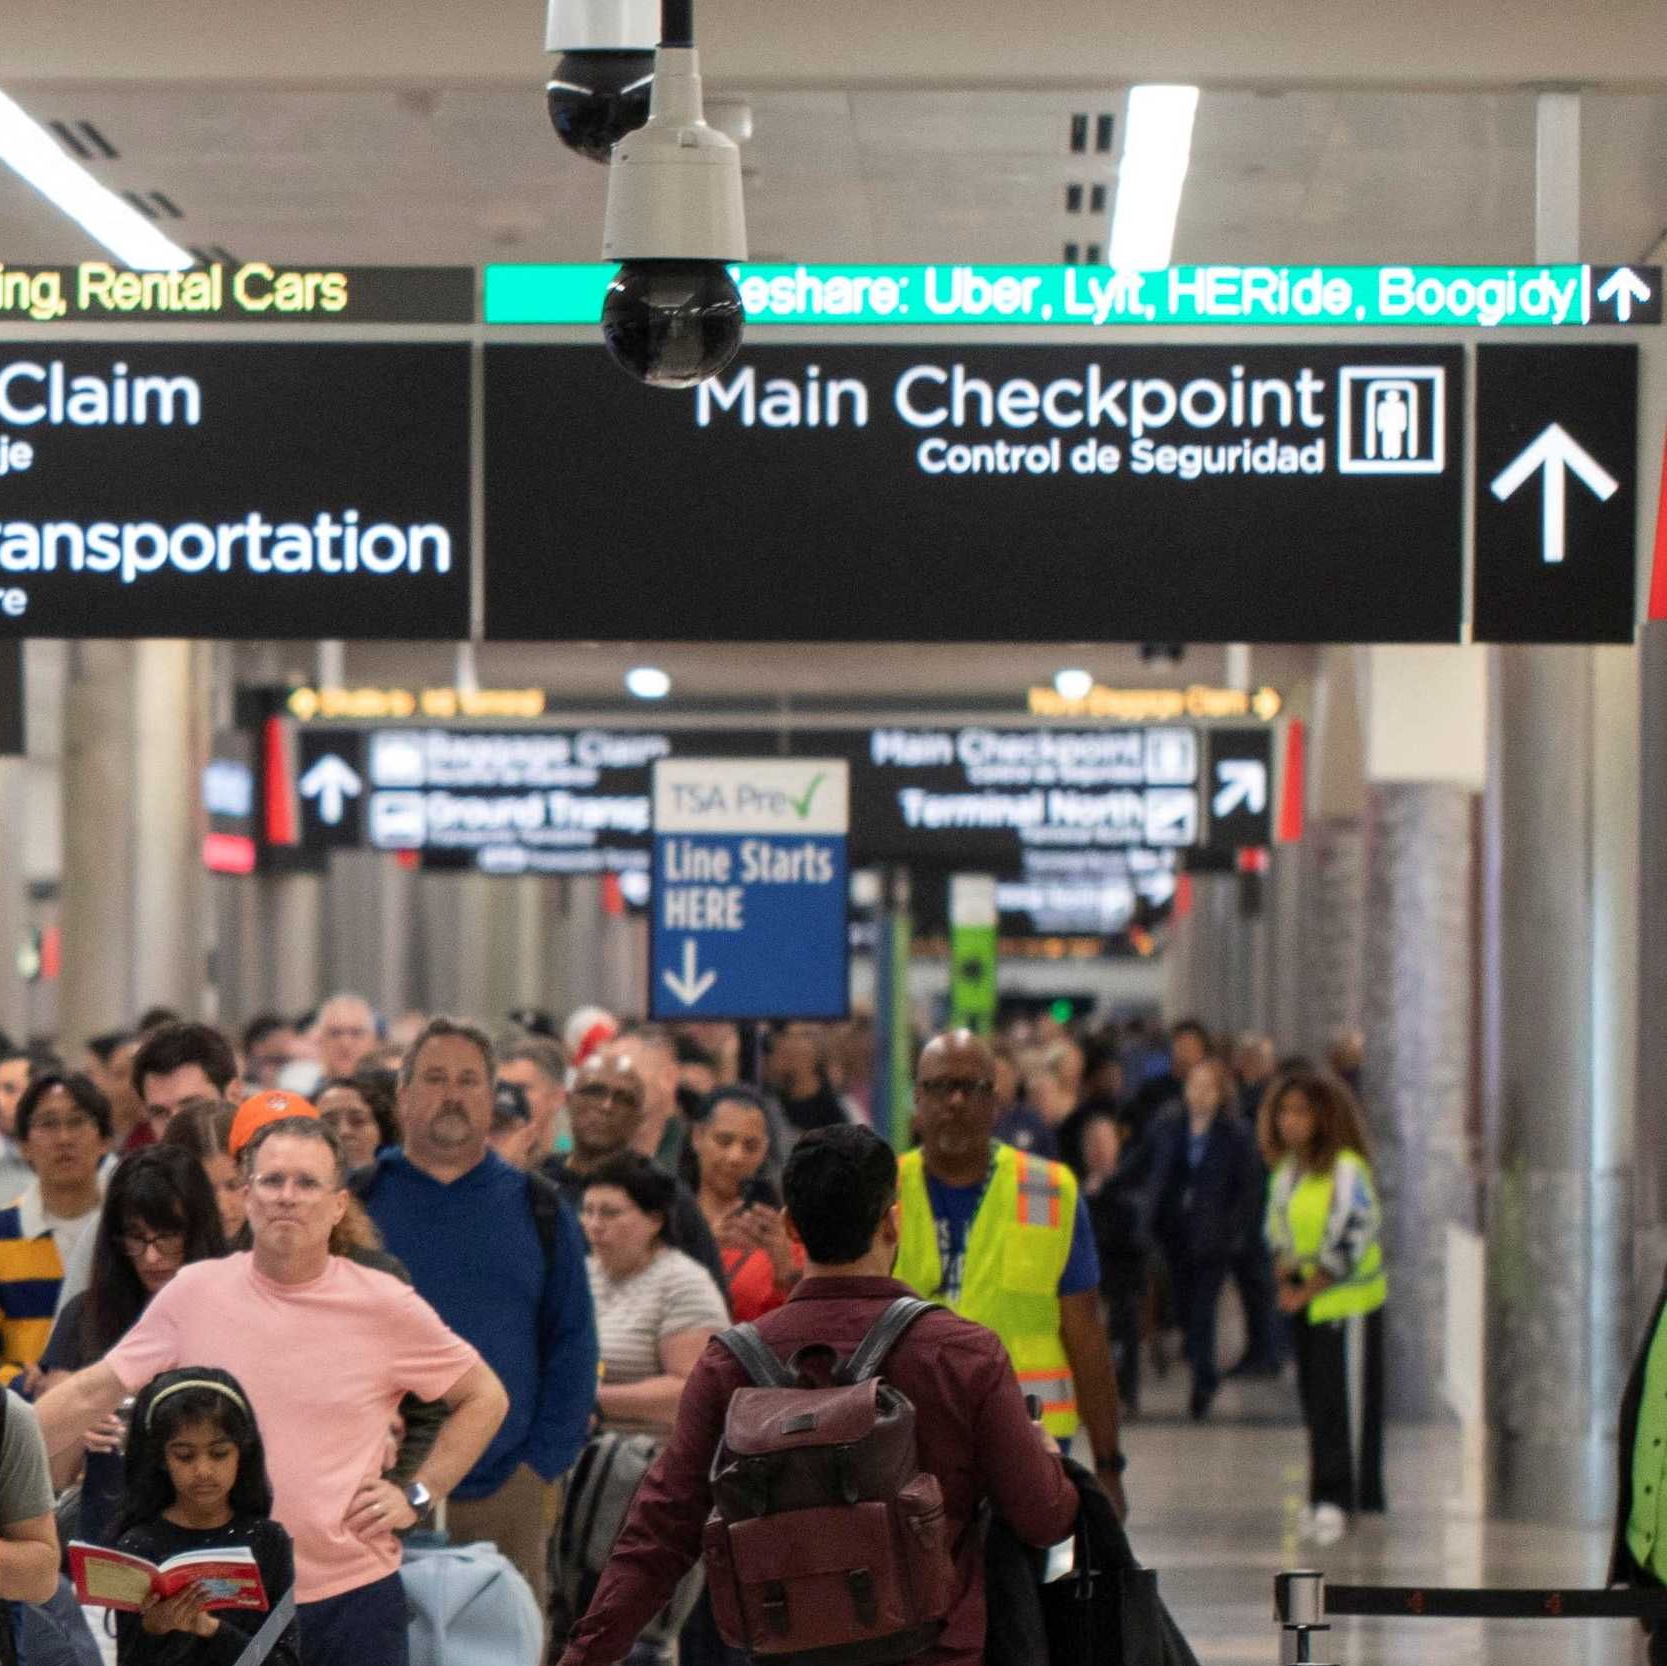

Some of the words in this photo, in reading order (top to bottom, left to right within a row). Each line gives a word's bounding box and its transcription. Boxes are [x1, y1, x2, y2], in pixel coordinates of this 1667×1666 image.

[77, 263, 223, 311] Rental
[233, 263, 348, 312] Cars
[924, 266, 1053, 321] Uber,
[1064, 268, 1157, 325] Lyft,
[1168, 267, 1365, 321] HERide,
[1378, 267, 1578, 326] Boogidy
[695, 365, 869, 428] Main
[894, 363, 1326, 438] Checkpoint
[917, 437, 1061, 474] Control
[1070, 437, 1121, 474] de
[1130, 434, 1326, 481] Seguridad
[671, 783, 726, 816] TSA
[663, 839, 731, 883] Line
[739, 839, 834, 884] Starts
[663, 885, 745, 931] HERE
